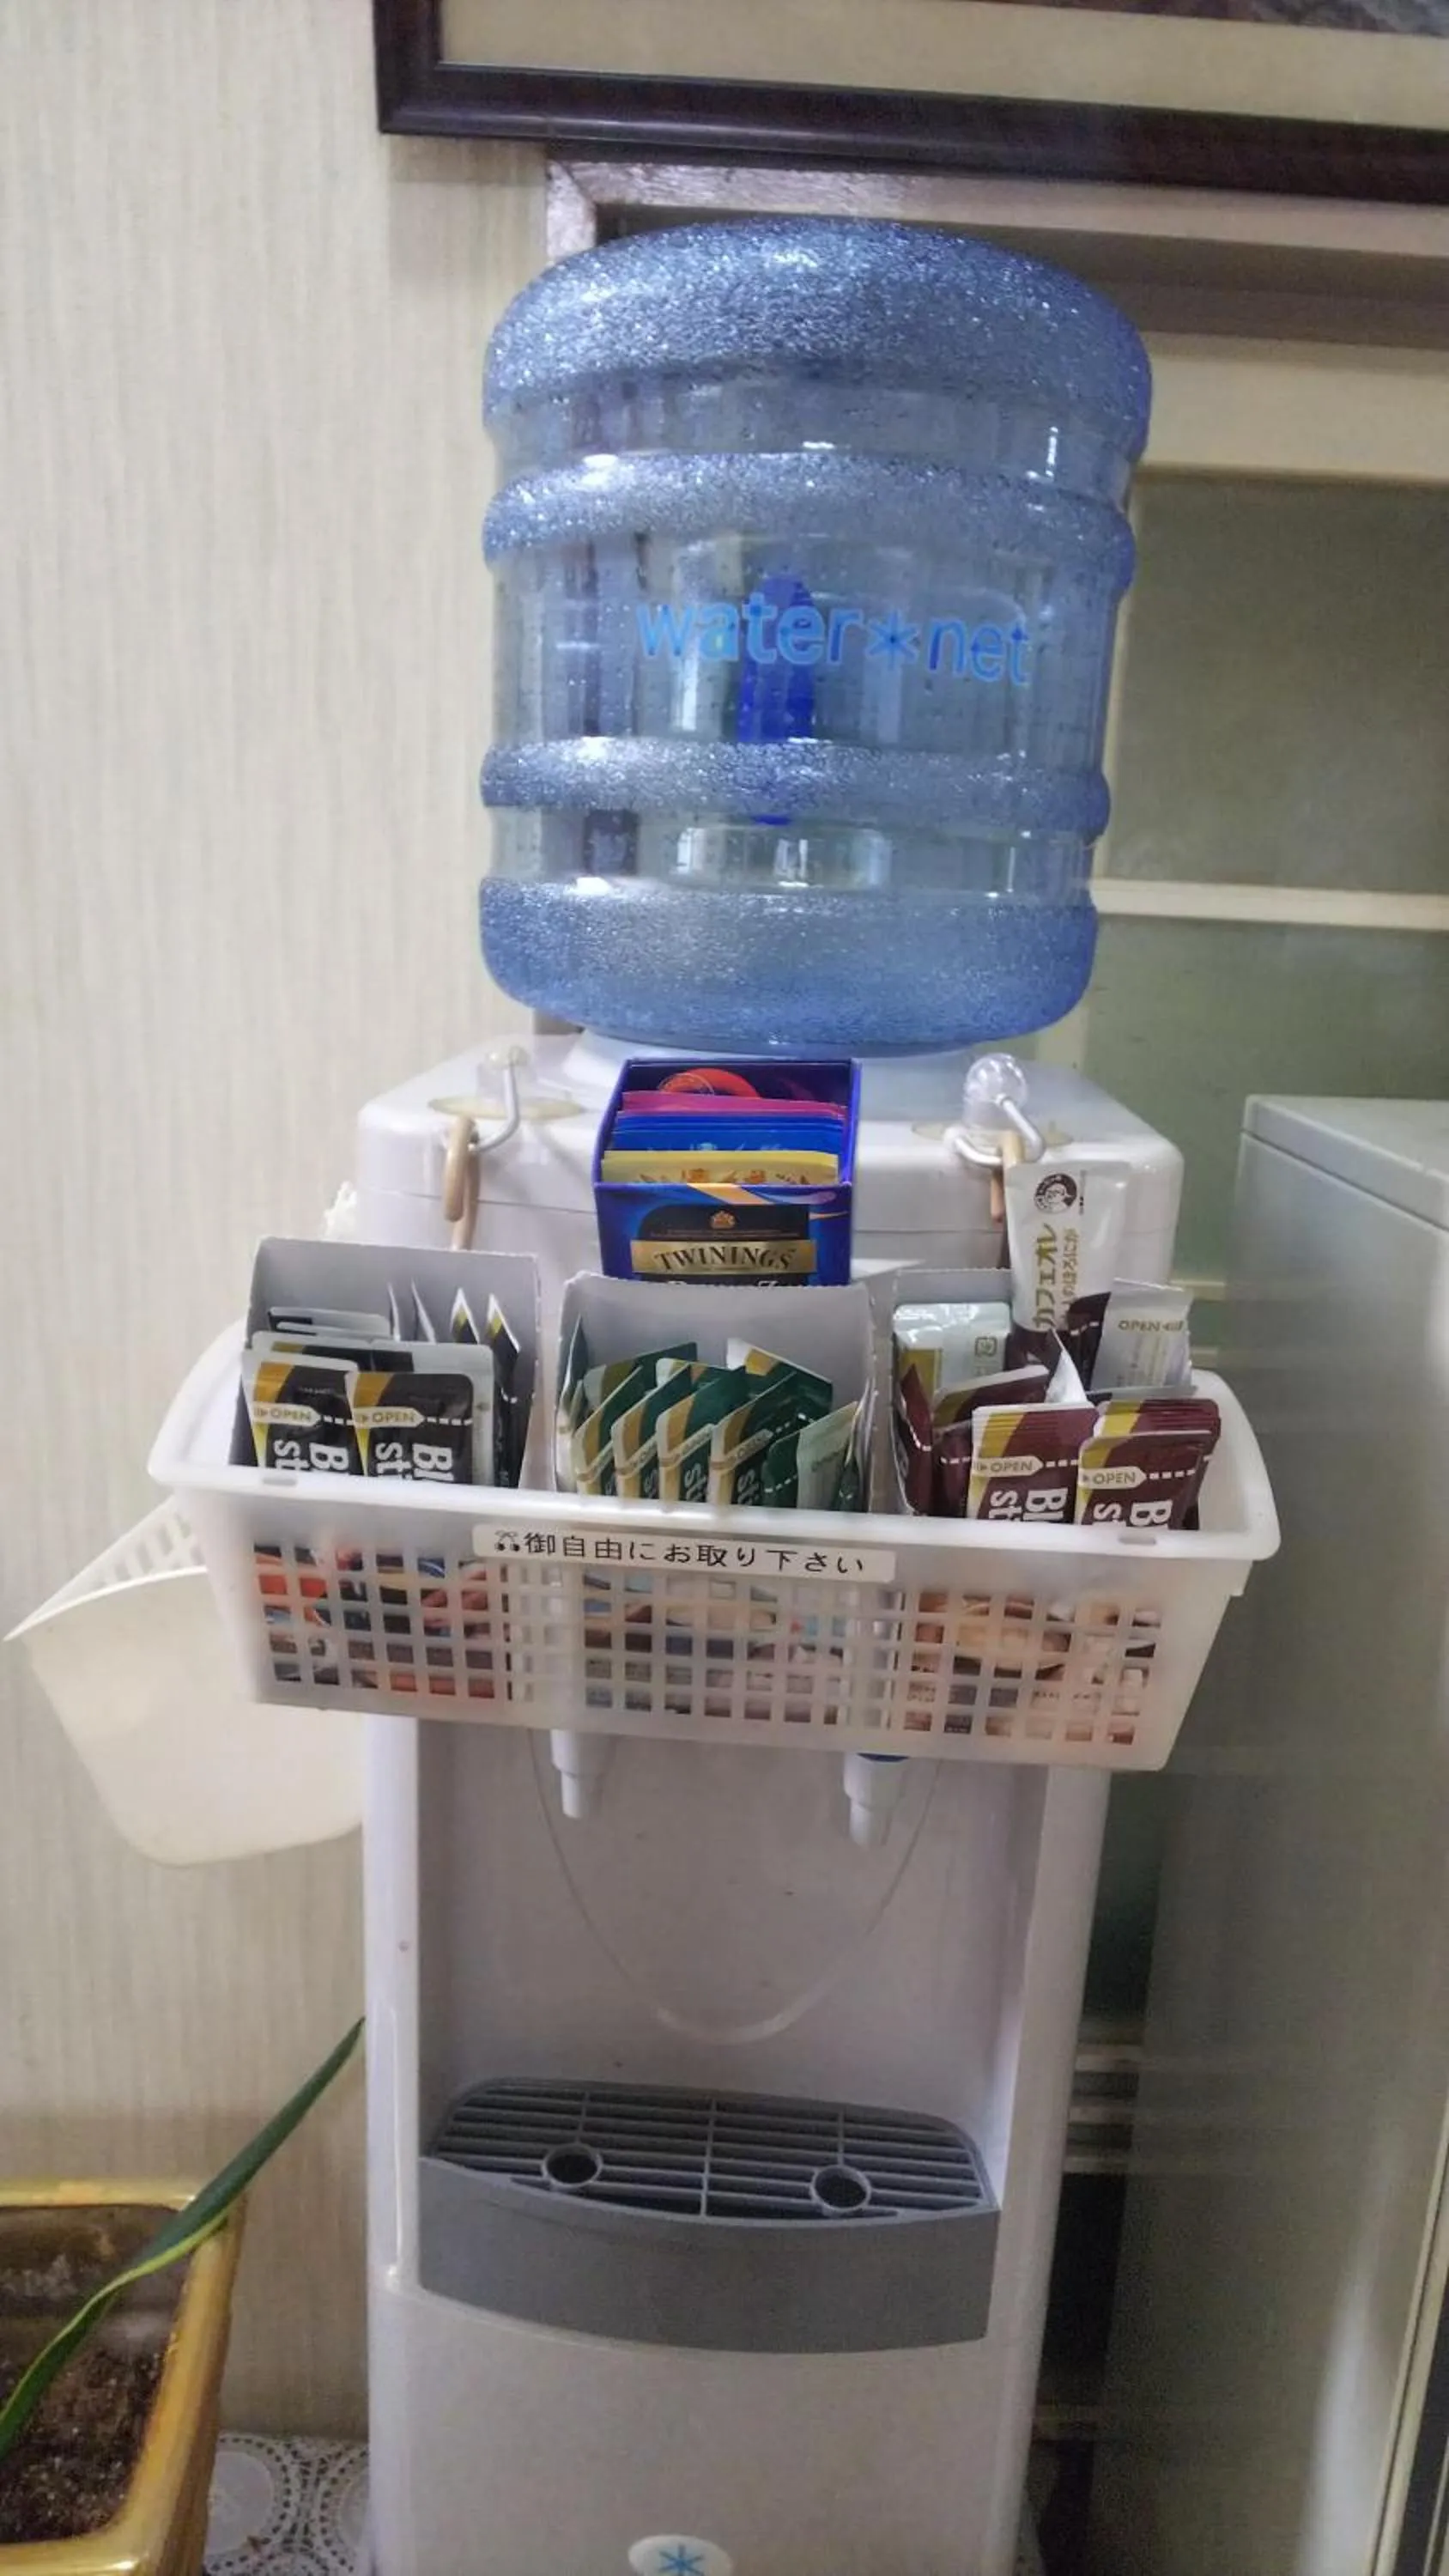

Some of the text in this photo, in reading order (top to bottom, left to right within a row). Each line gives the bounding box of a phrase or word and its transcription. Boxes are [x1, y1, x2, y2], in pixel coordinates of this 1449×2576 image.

[654, 1246, 795, 1271] TWININGS
[1118, 1320, 1161, 1332] OPEN
[270, 1408, 312, 1422] OPEN
[372, 1411, 416, 1424] OPEN
[990, 1461, 1033, 1473] OPEN
[1092, 1472, 1137, 1485] OPEN
[524, 1531, 863, 1574] 御自由にお取り下さい
